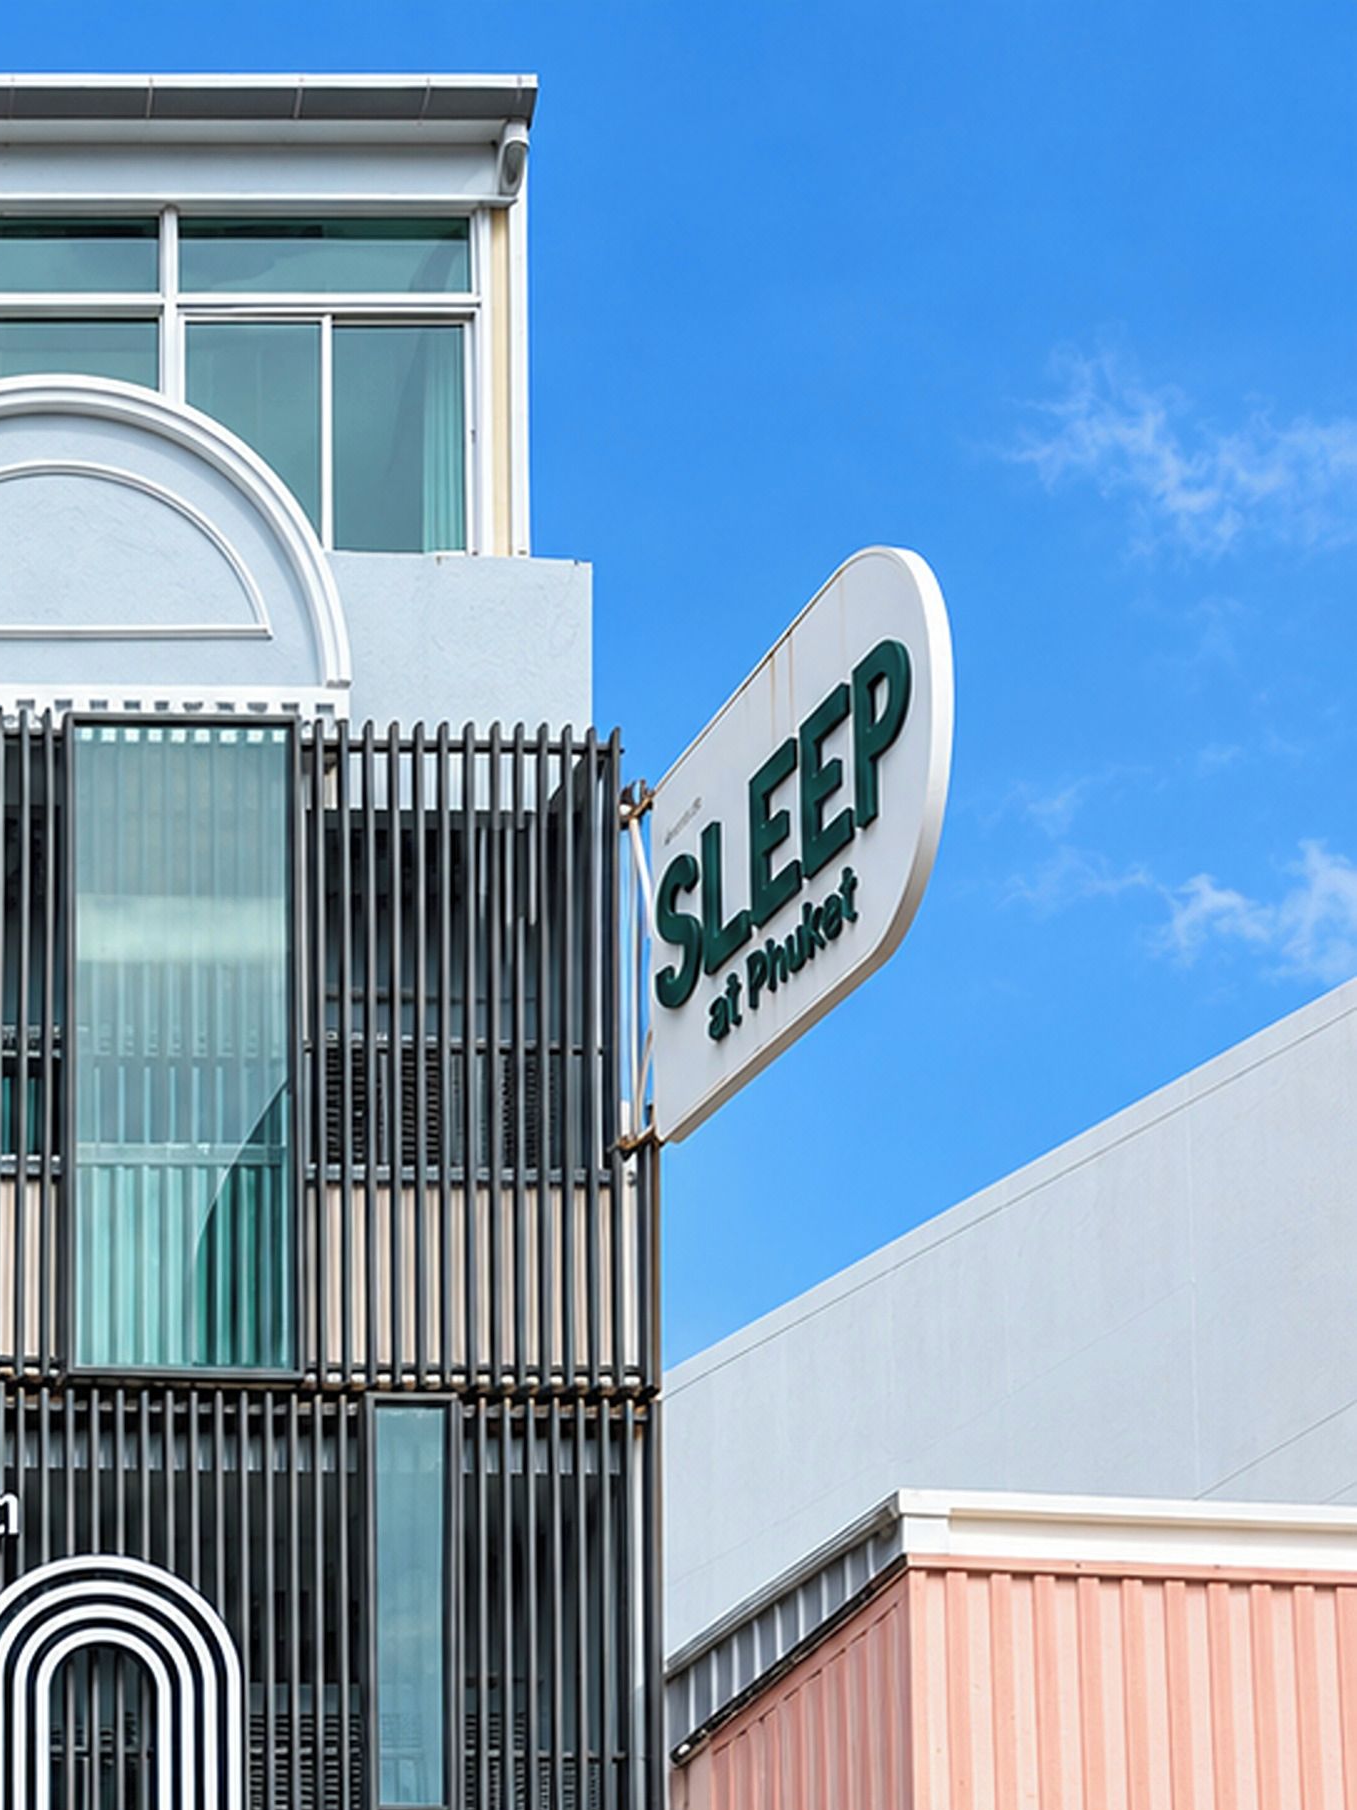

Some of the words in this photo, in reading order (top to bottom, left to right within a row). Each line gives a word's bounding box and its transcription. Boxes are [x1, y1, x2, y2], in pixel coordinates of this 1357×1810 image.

[654, 638, 912, 1009] SLEEP
[707, 972, 742, 1042] at
[746, 868, 859, 1010] Phuket
